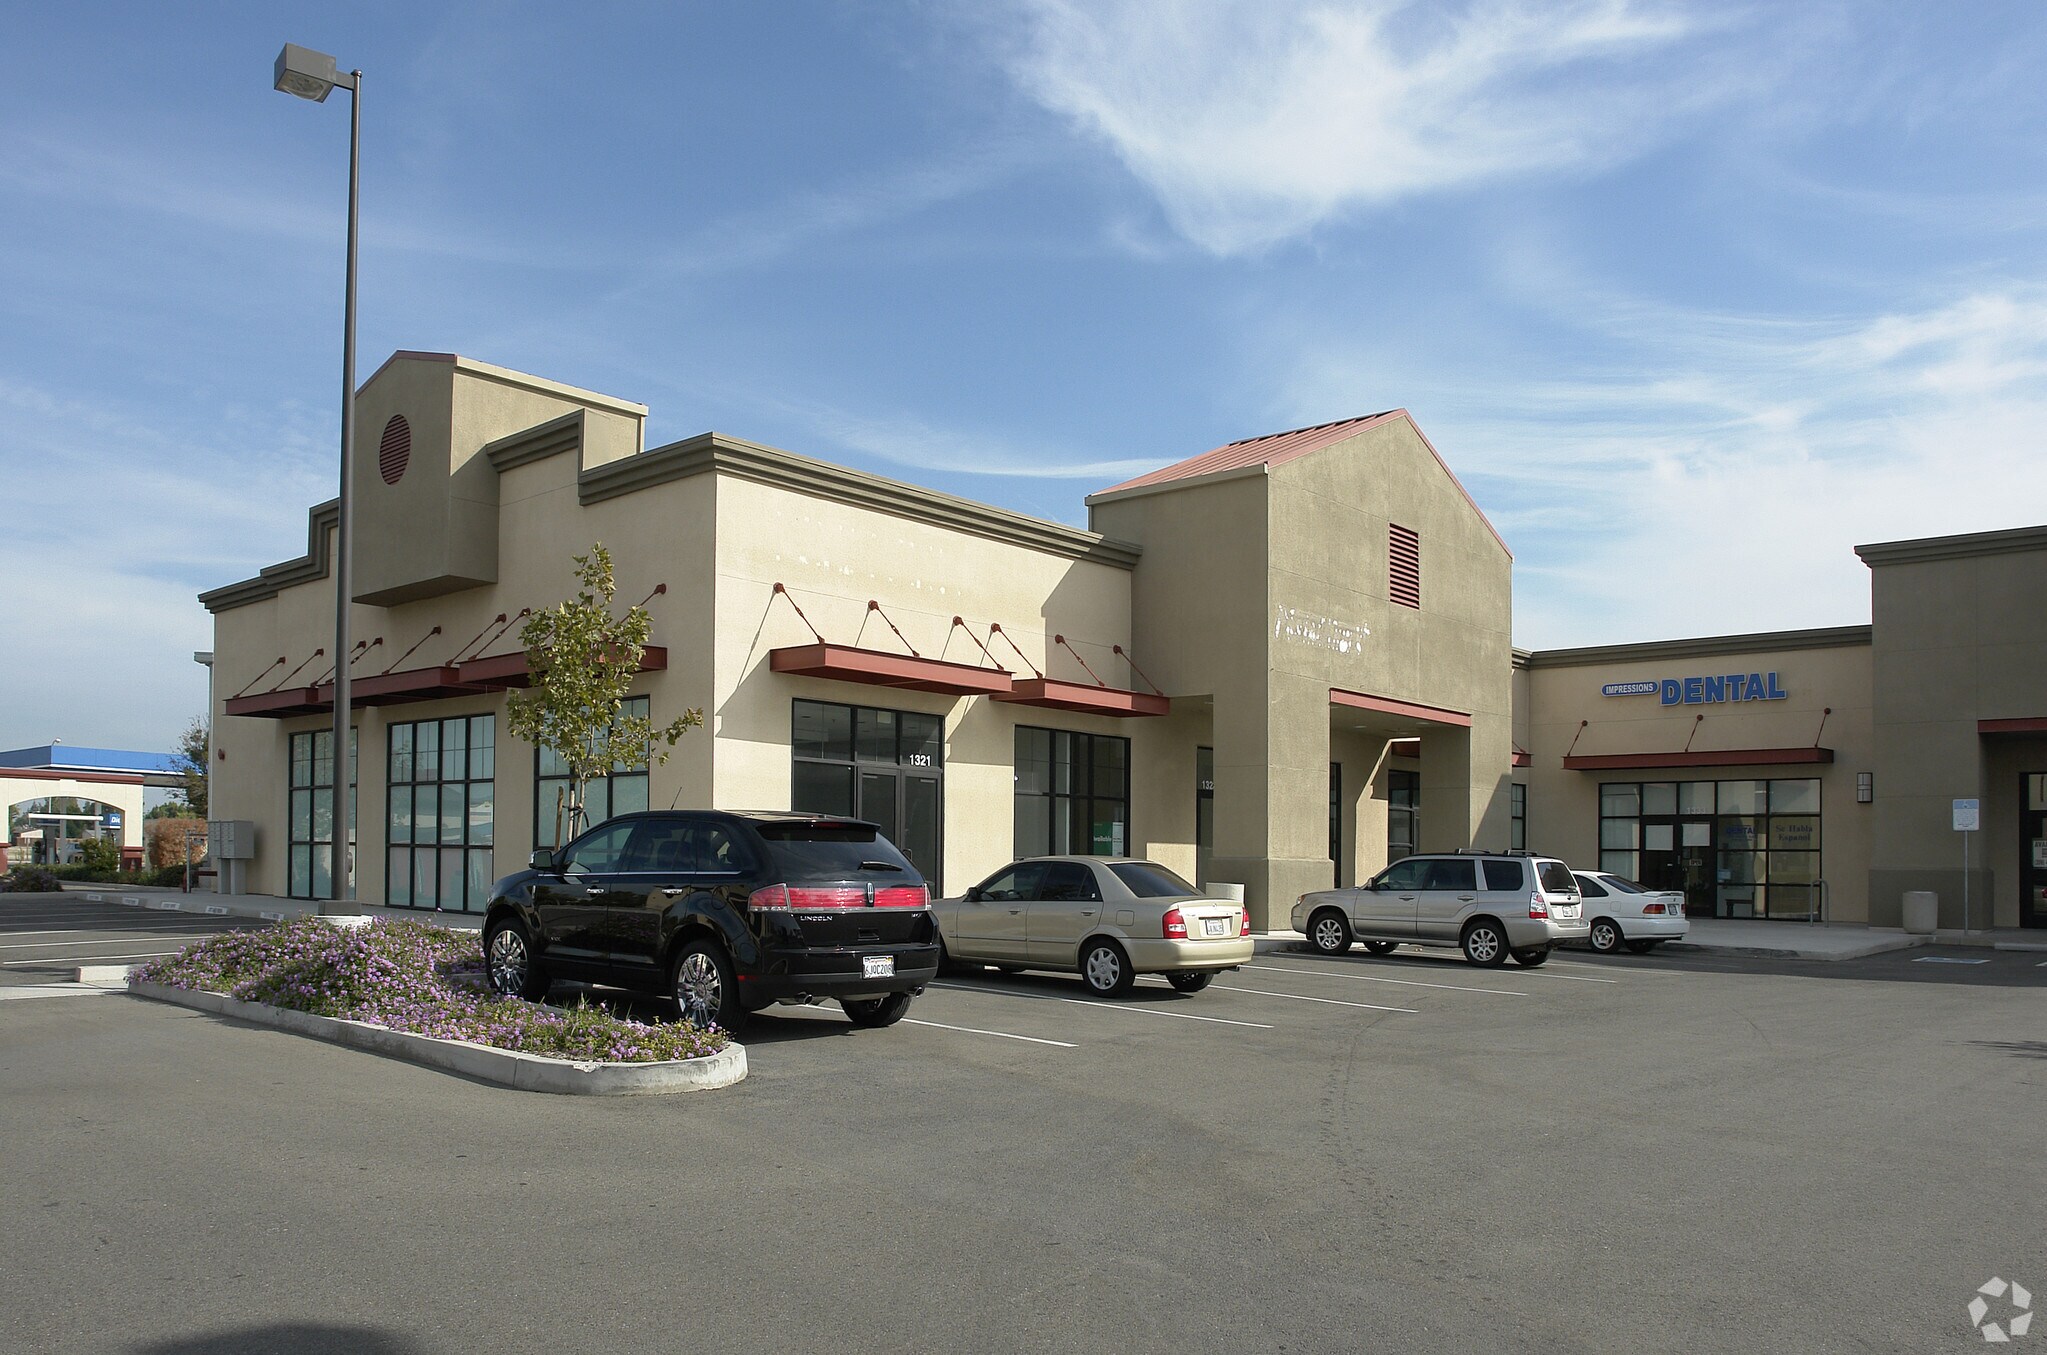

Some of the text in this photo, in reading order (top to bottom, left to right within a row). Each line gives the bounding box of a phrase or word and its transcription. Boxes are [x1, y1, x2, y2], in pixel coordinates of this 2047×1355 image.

[1605, 672, 1786, 706] IMPRESSIONS DENTAL
[910, 754, 931, 767] 1321
